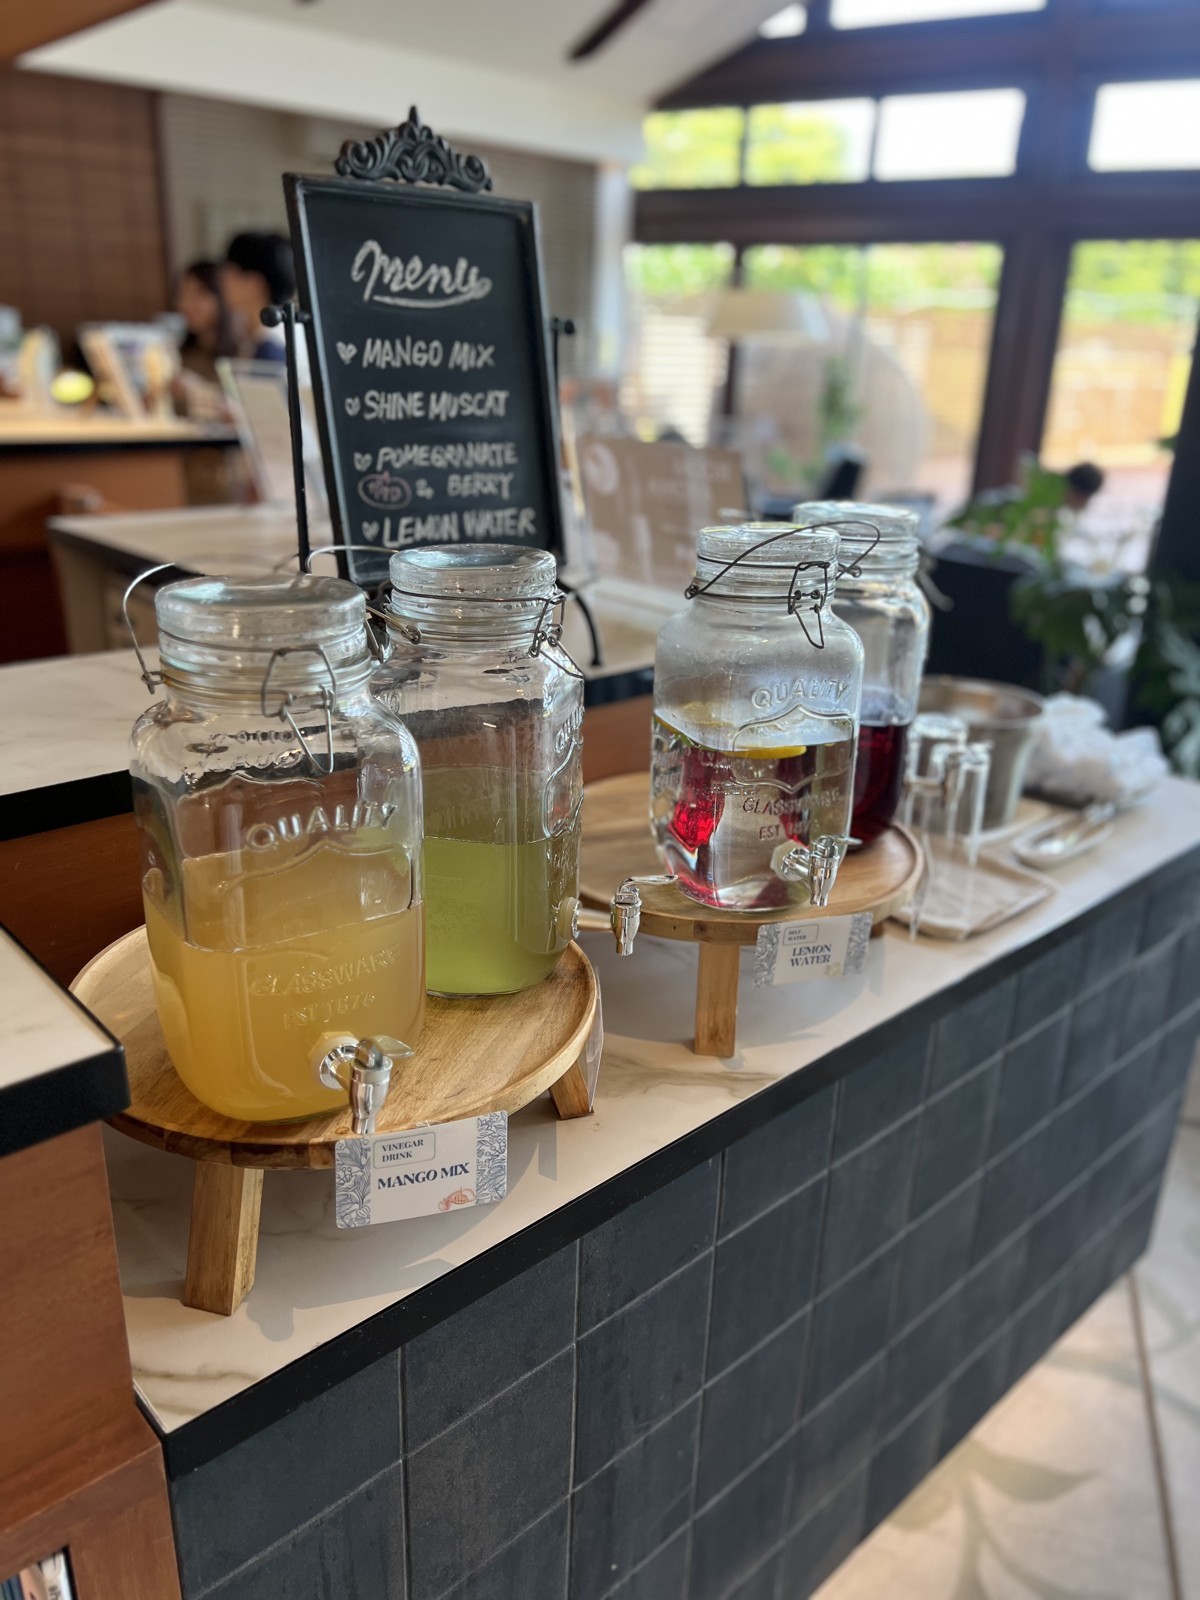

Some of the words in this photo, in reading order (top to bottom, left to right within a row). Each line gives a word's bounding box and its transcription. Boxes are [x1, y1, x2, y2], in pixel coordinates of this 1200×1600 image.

[351, 239, 492, 302] Menu
[362, 337, 443, 370] MANGO
[448, 341, 496, 371] MIX
[363, 390, 425, 420] SHINE
[429, 390, 510, 422] MUSCAT
[447, 472, 514, 499] BERRY
[382, 511, 460, 548] LEMON
[463, 506, 537, 540] WATER
[751, 678, 849, 709] QUALITY
[246, 800, 398, 850] QUALITY
[790, 954, 831, 967] WATER
[792, 944, 832, 957] LEMON
[250, 944, 401, 996] GLASSWARE
[382, 1139, 424, 1152] VINEGAR
[382, 1151, 414, 1163] DRINK
[377, 1169, 438, 1190] MANGO
[440, 1162, 471, 1178] MIX
